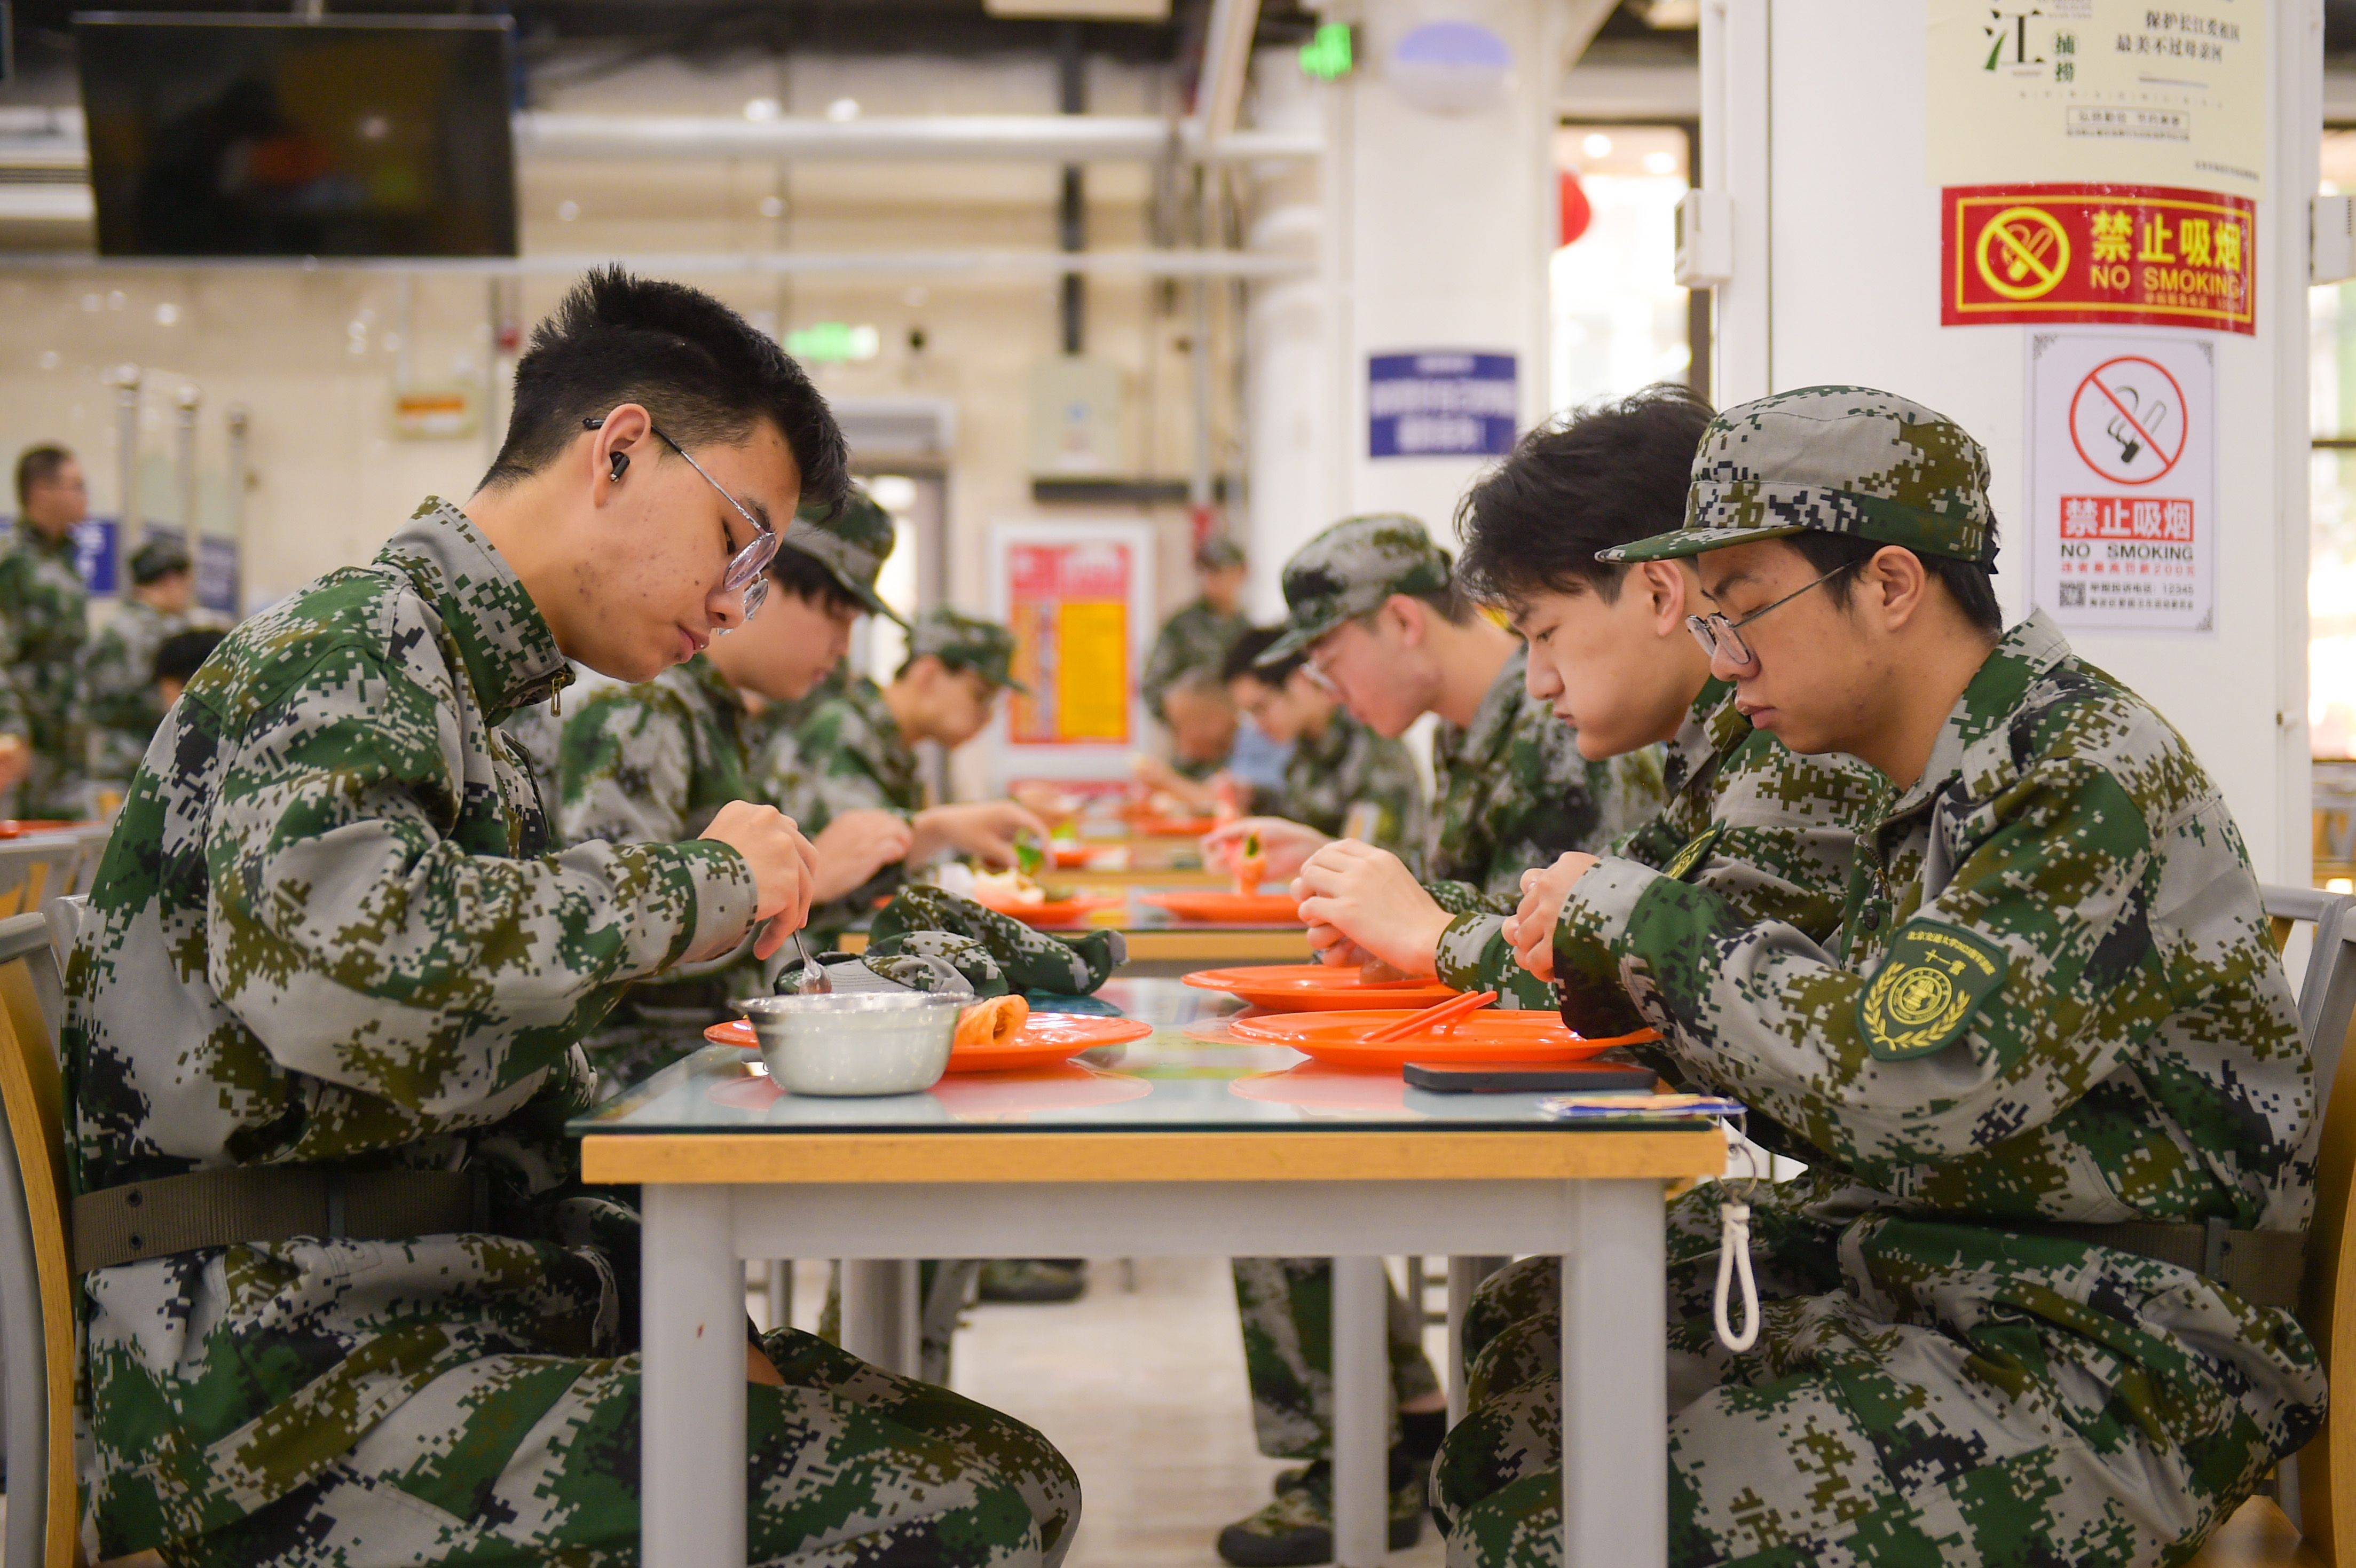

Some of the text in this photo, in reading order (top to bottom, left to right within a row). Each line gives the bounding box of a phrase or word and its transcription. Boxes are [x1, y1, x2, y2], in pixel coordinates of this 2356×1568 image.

[1983, 8, 2047, 71] 江
[2147, 10, 2240, 42] 保护长江爱祖国
[2055, 31, 2076, 82] 捕捞
[2117, 33, 2223, 63] 最美不过母亲河
[2091, 210, 2242, 271] 禁止吸烟
[2091, 265, 2241, 299] NO SMOKING
[2065, 498, 2190, 539] 禁止吸烟
[2061, 543, 2193, 560] NO SMOKING
